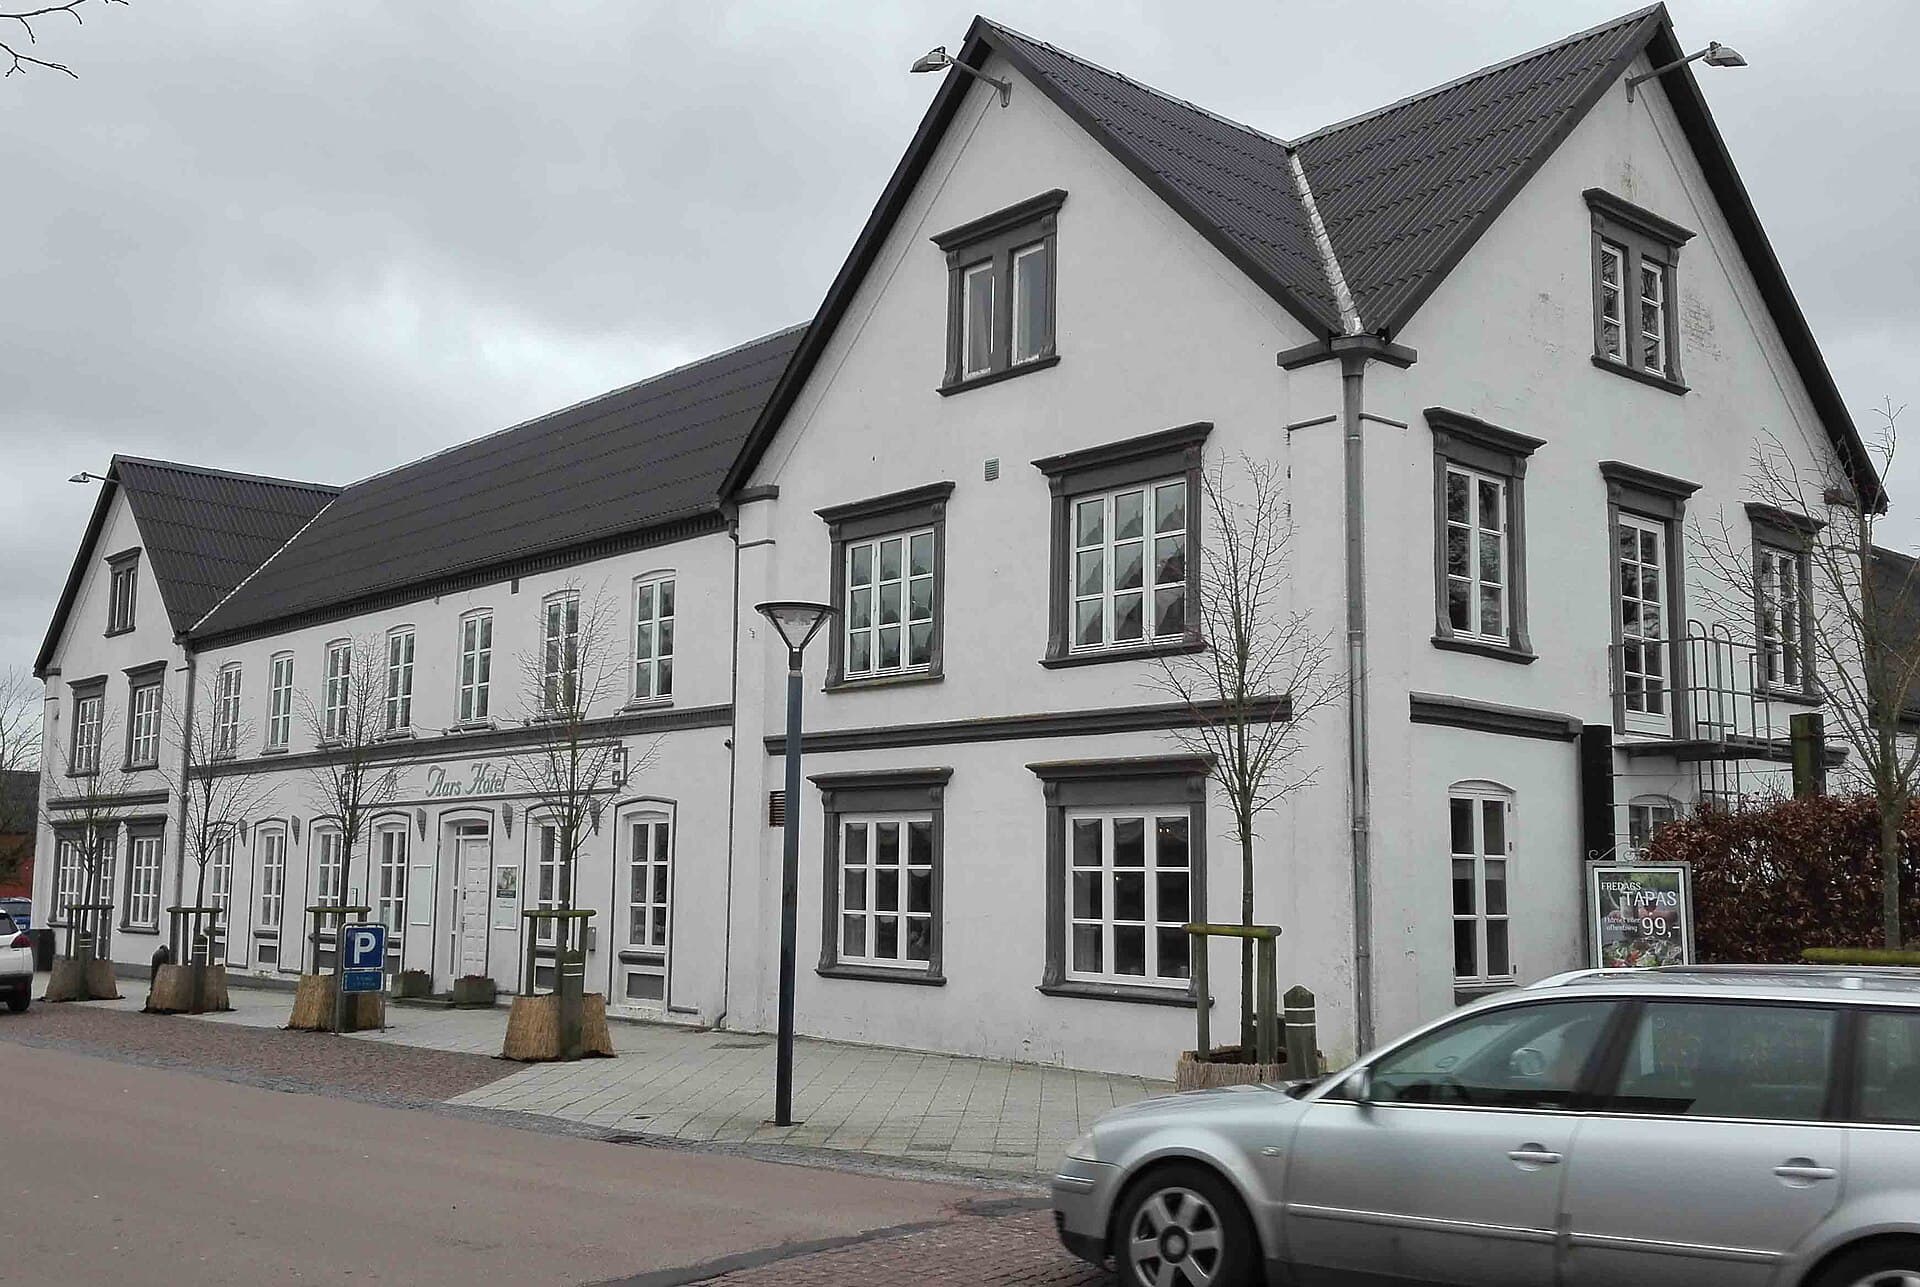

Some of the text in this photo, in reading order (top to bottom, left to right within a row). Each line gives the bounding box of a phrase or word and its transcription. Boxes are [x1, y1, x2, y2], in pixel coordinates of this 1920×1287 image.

[425, 762, 510, 797] Aars Hotel
[1601, 881, 1641, 891] FREDAGS
[1622, 890, 1677, 907] TAPAS
[1641, 916, 1680, 938] 99,-
[353, 932, 376, 964] P
